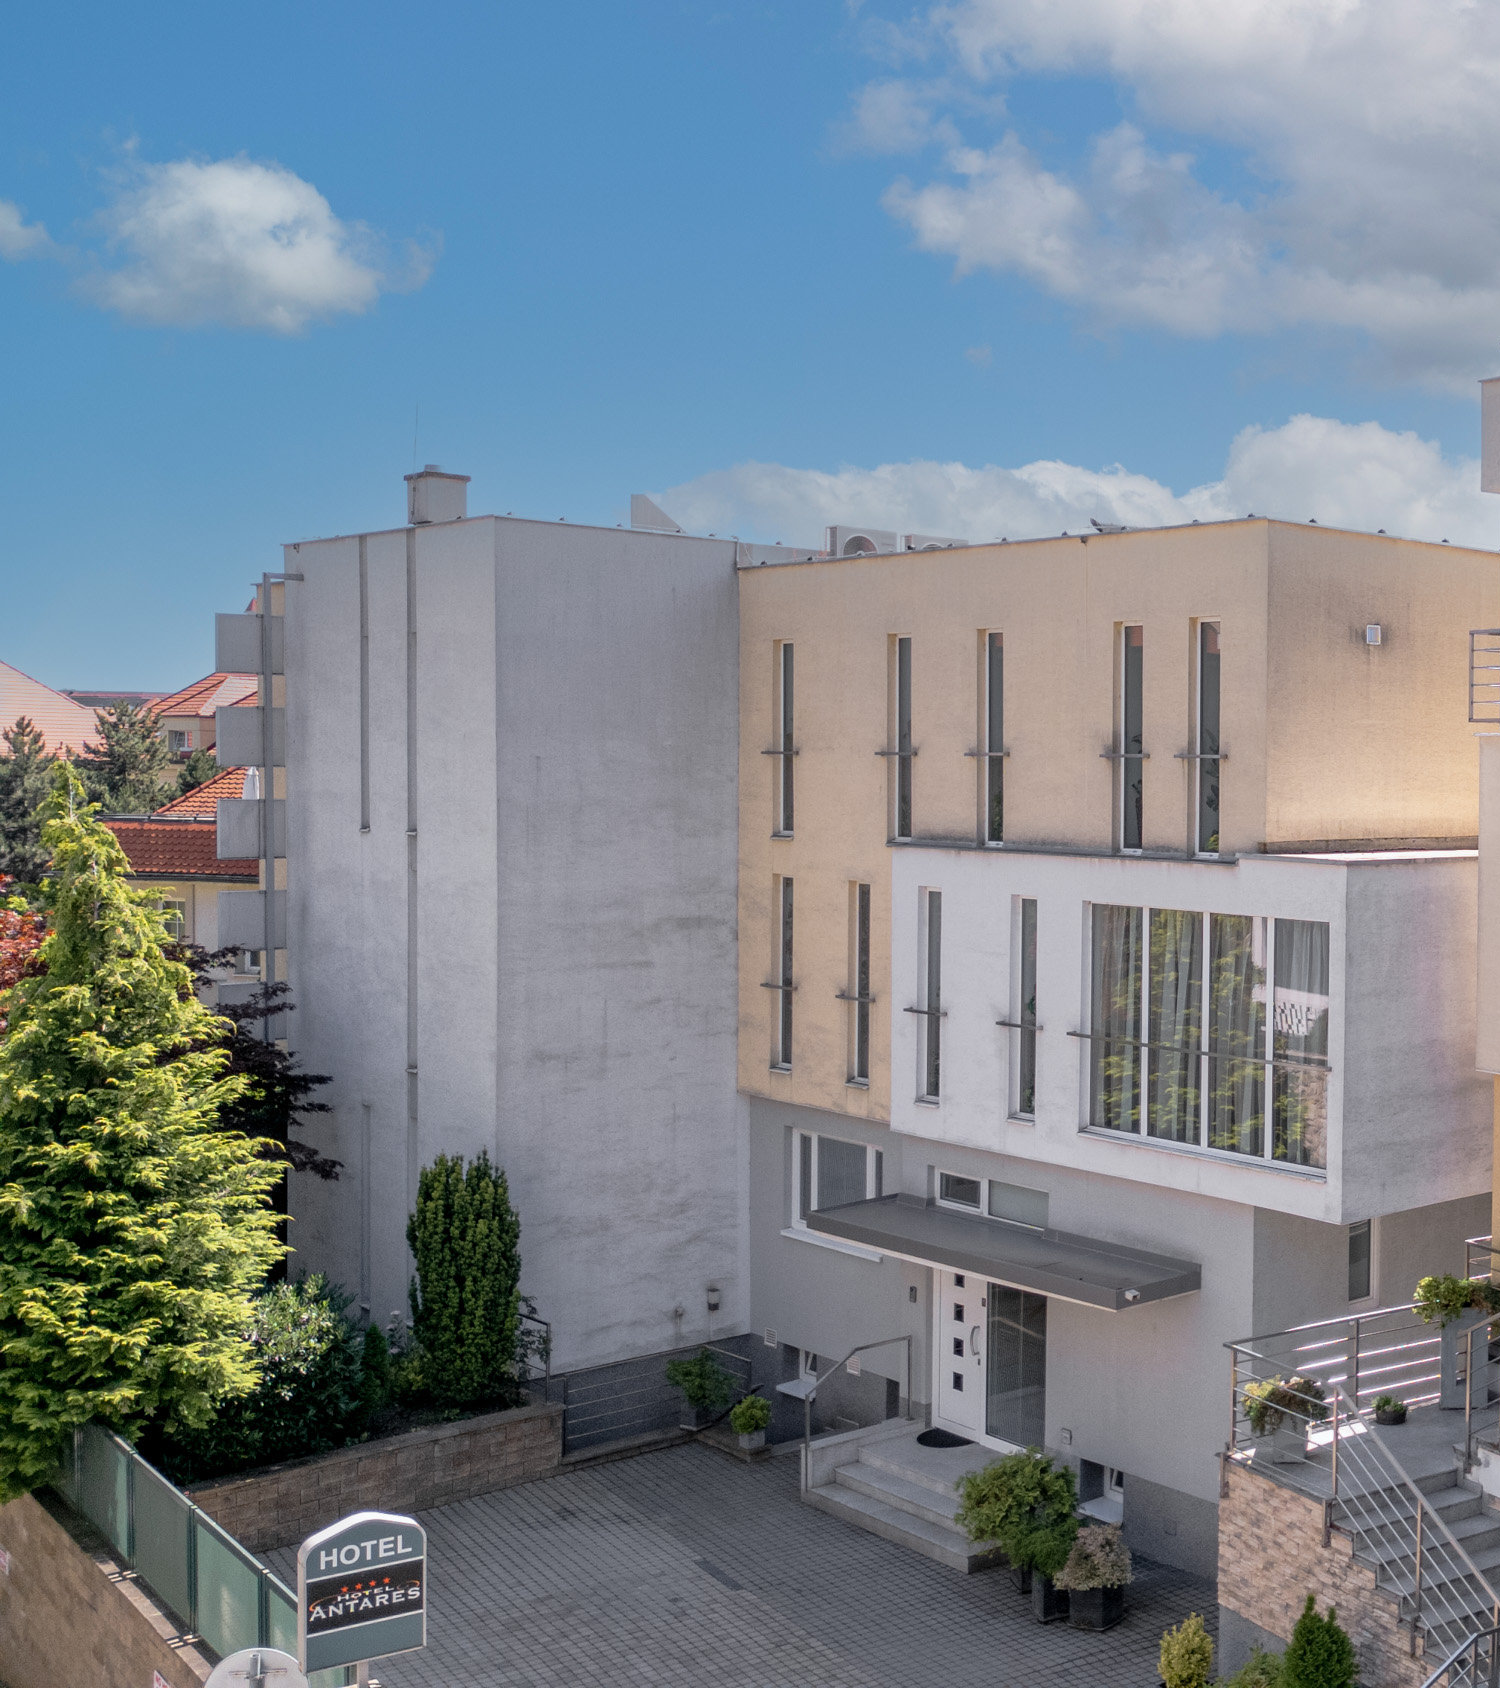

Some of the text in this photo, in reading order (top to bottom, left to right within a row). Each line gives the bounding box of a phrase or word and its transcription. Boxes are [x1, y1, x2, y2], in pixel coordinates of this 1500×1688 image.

[320, 1535, 412, 1570] HOTEL
[309, 1587, 420, 1621] ANTARES
[337, 1586, 395, 1601] HOTEL
